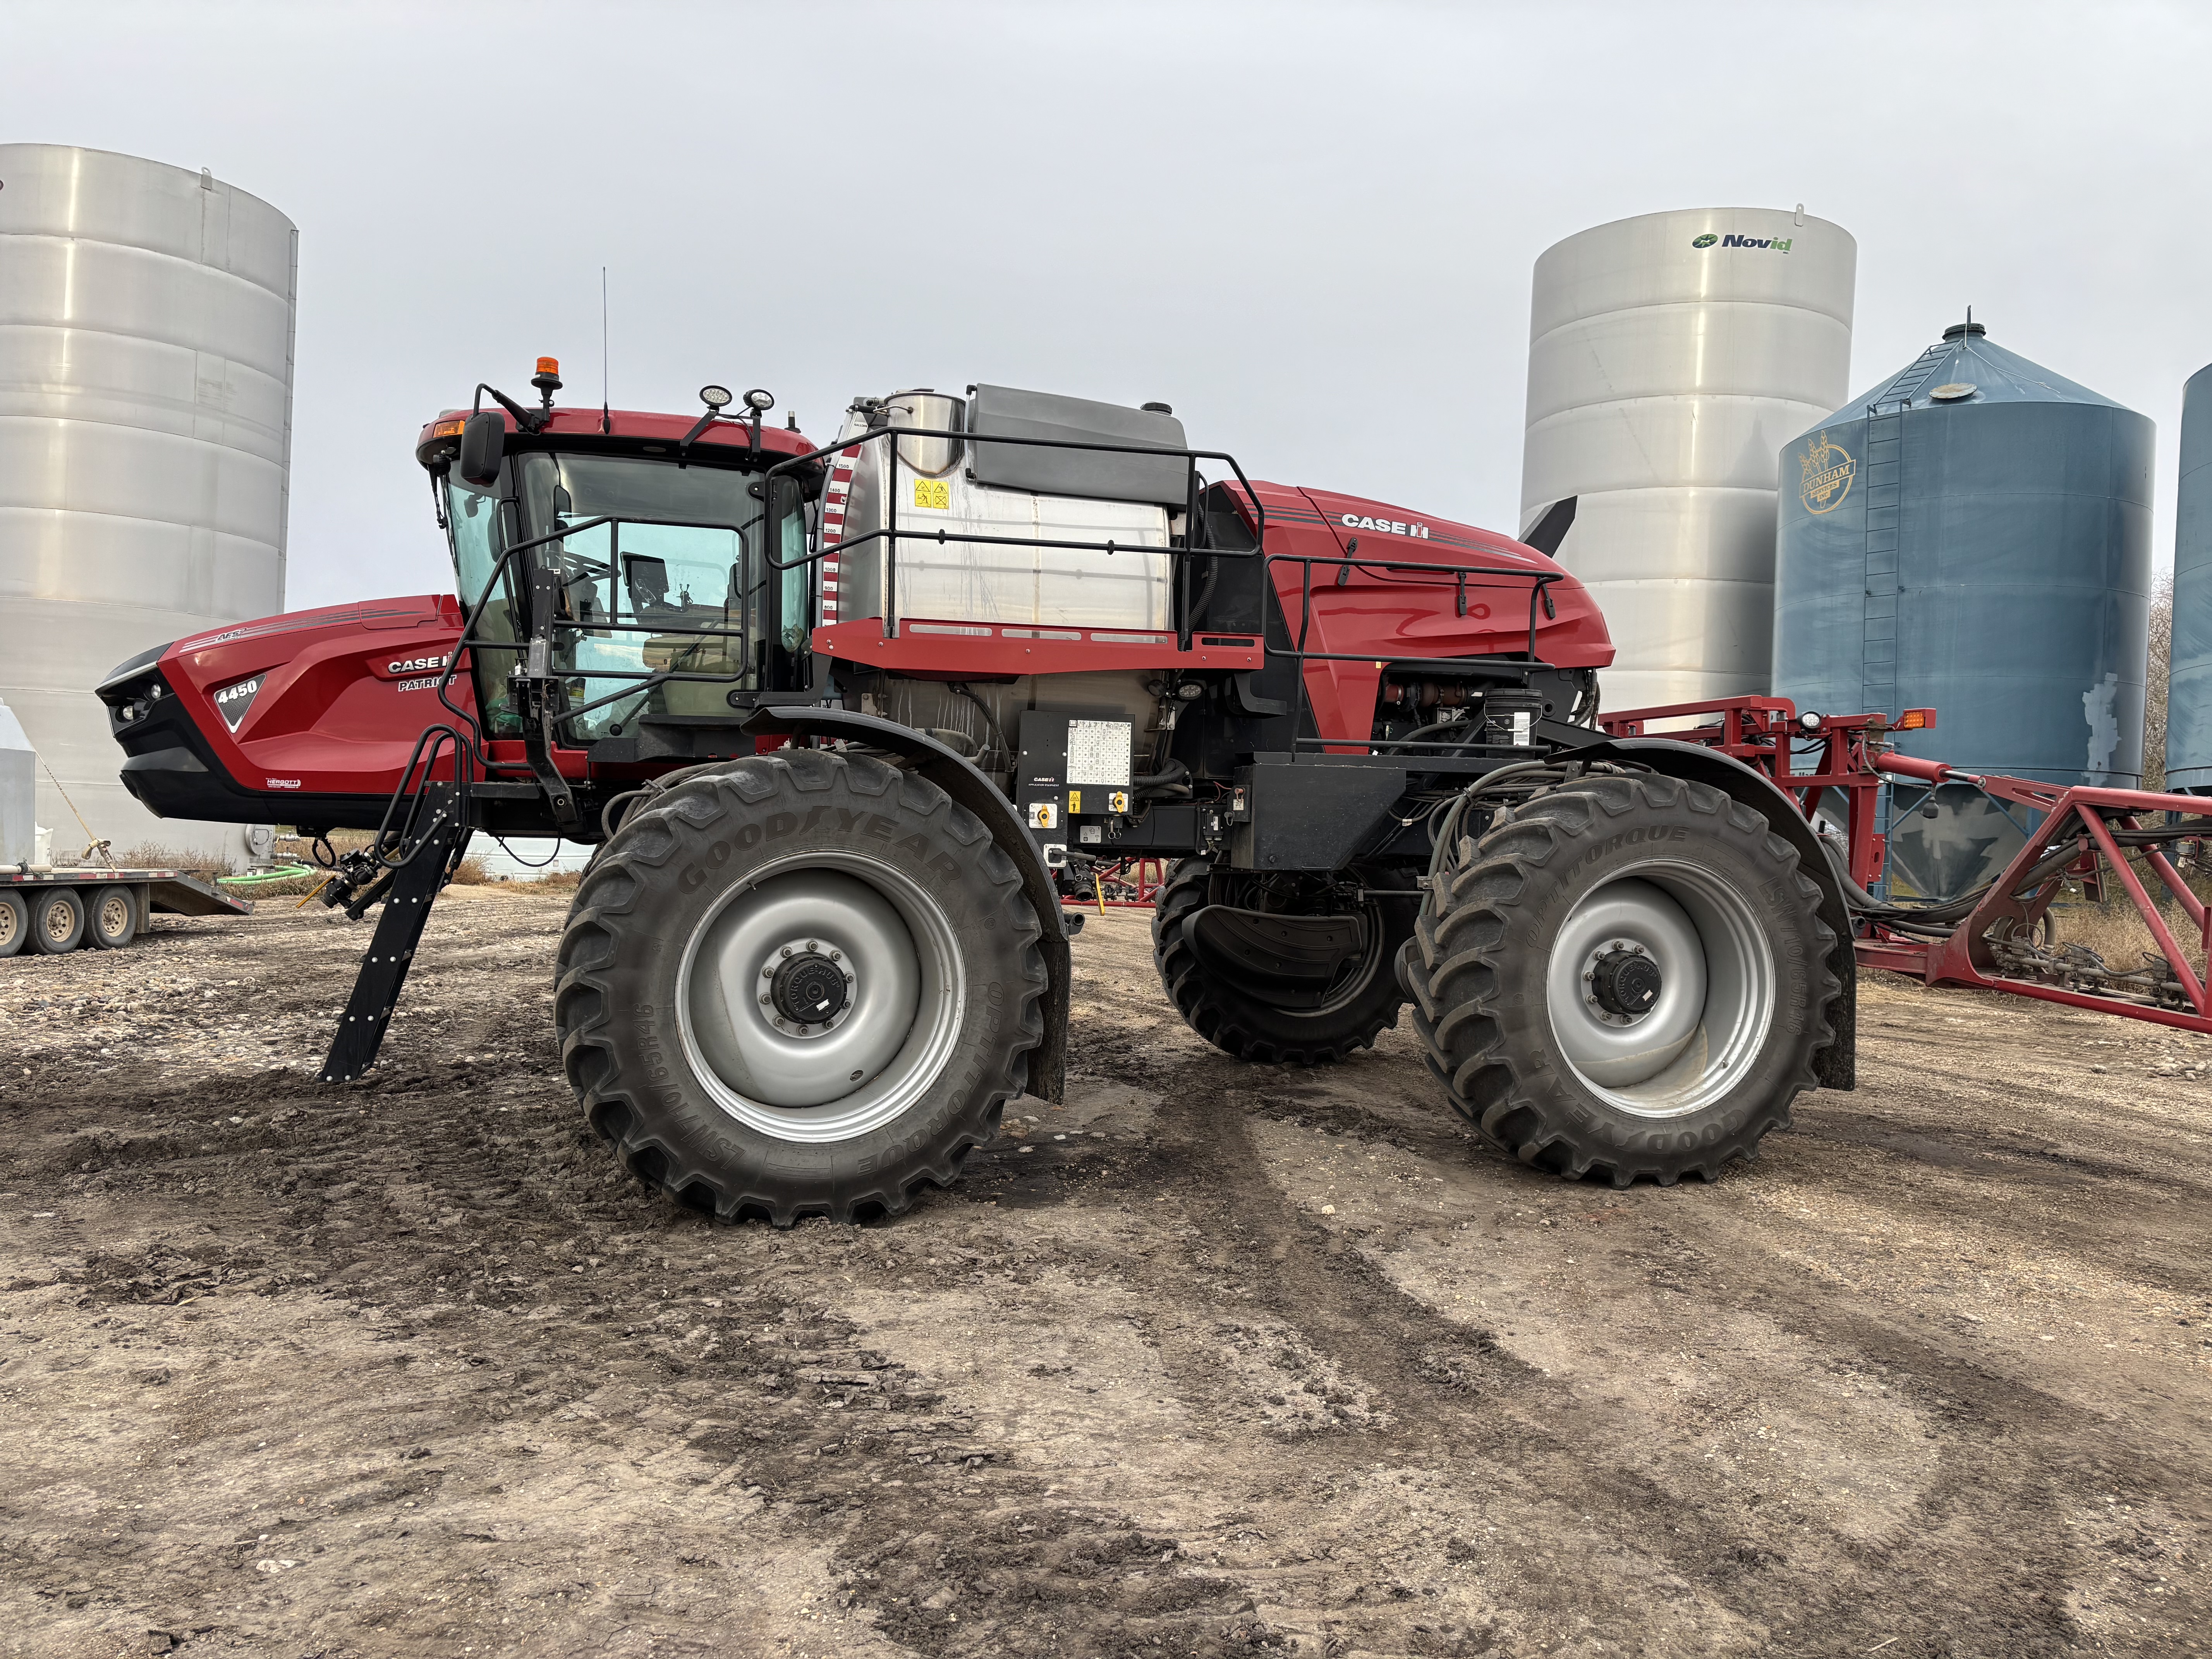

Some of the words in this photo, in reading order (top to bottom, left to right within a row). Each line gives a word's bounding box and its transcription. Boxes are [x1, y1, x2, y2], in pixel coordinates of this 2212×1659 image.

[1722, 234, 1793, 251] Novid
[1803, 465, 1850, 493] DUNHAM
[1813, 482, 1837, 496] SERVICES
[1341, 514, 1407, 535] CASE
[388, 656, 439, 673] CASE
[218, 680, 257, 704] 4450
[677, 805, 963, 894] GOODYEAR
[1526, 824, 1690, 948] OPTITORQUE
[856, 982, 1005, 1177] OPTITORQUE
[1529, 1048, 1747, 1154] GOODYEAR
